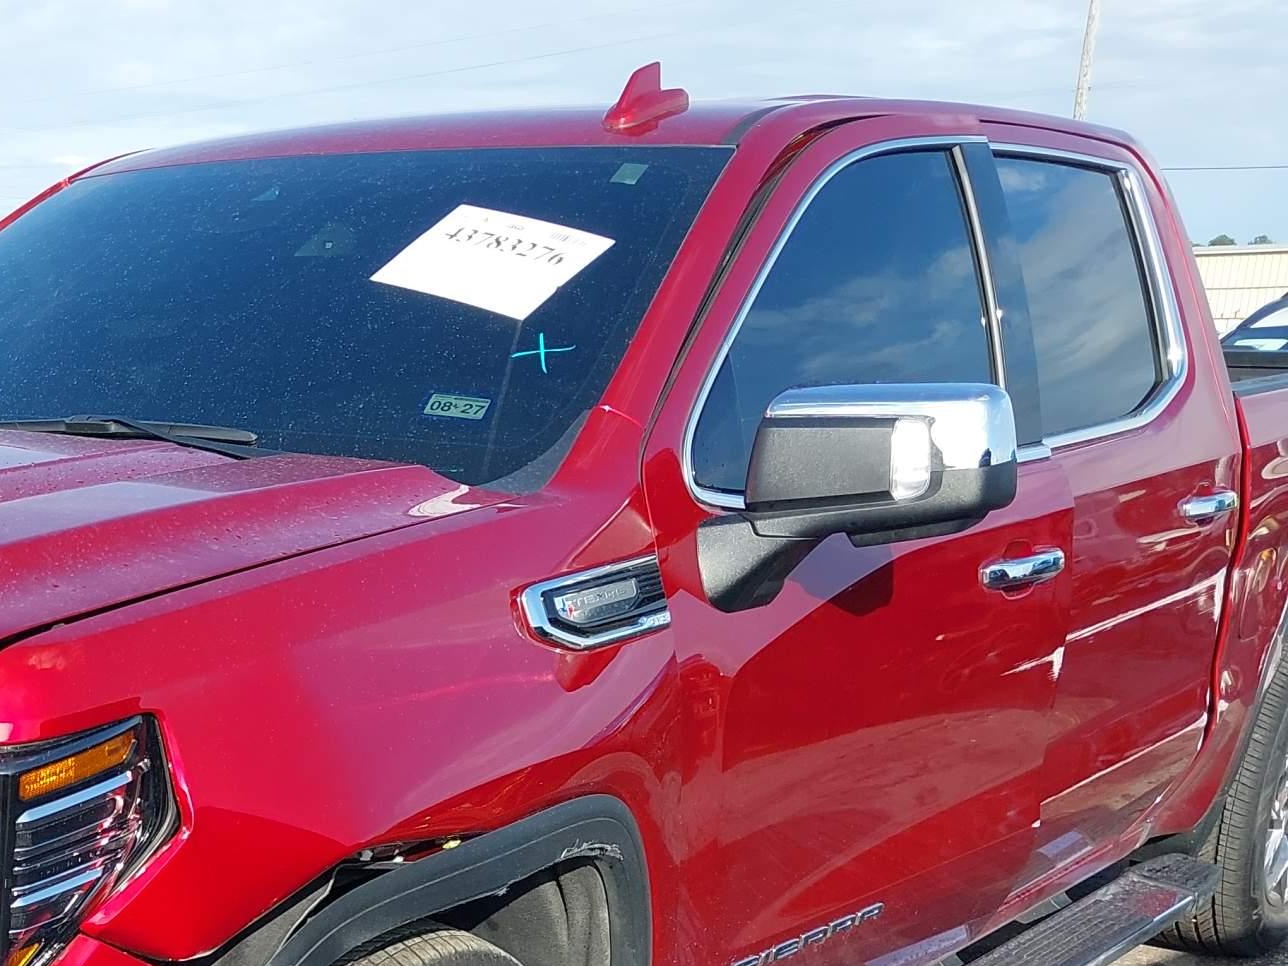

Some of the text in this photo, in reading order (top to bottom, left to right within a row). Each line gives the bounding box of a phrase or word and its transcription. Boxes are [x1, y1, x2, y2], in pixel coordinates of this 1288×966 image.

[444, 226, 565, 266] 43783276
[430, 400, 486, 415] 08 27
